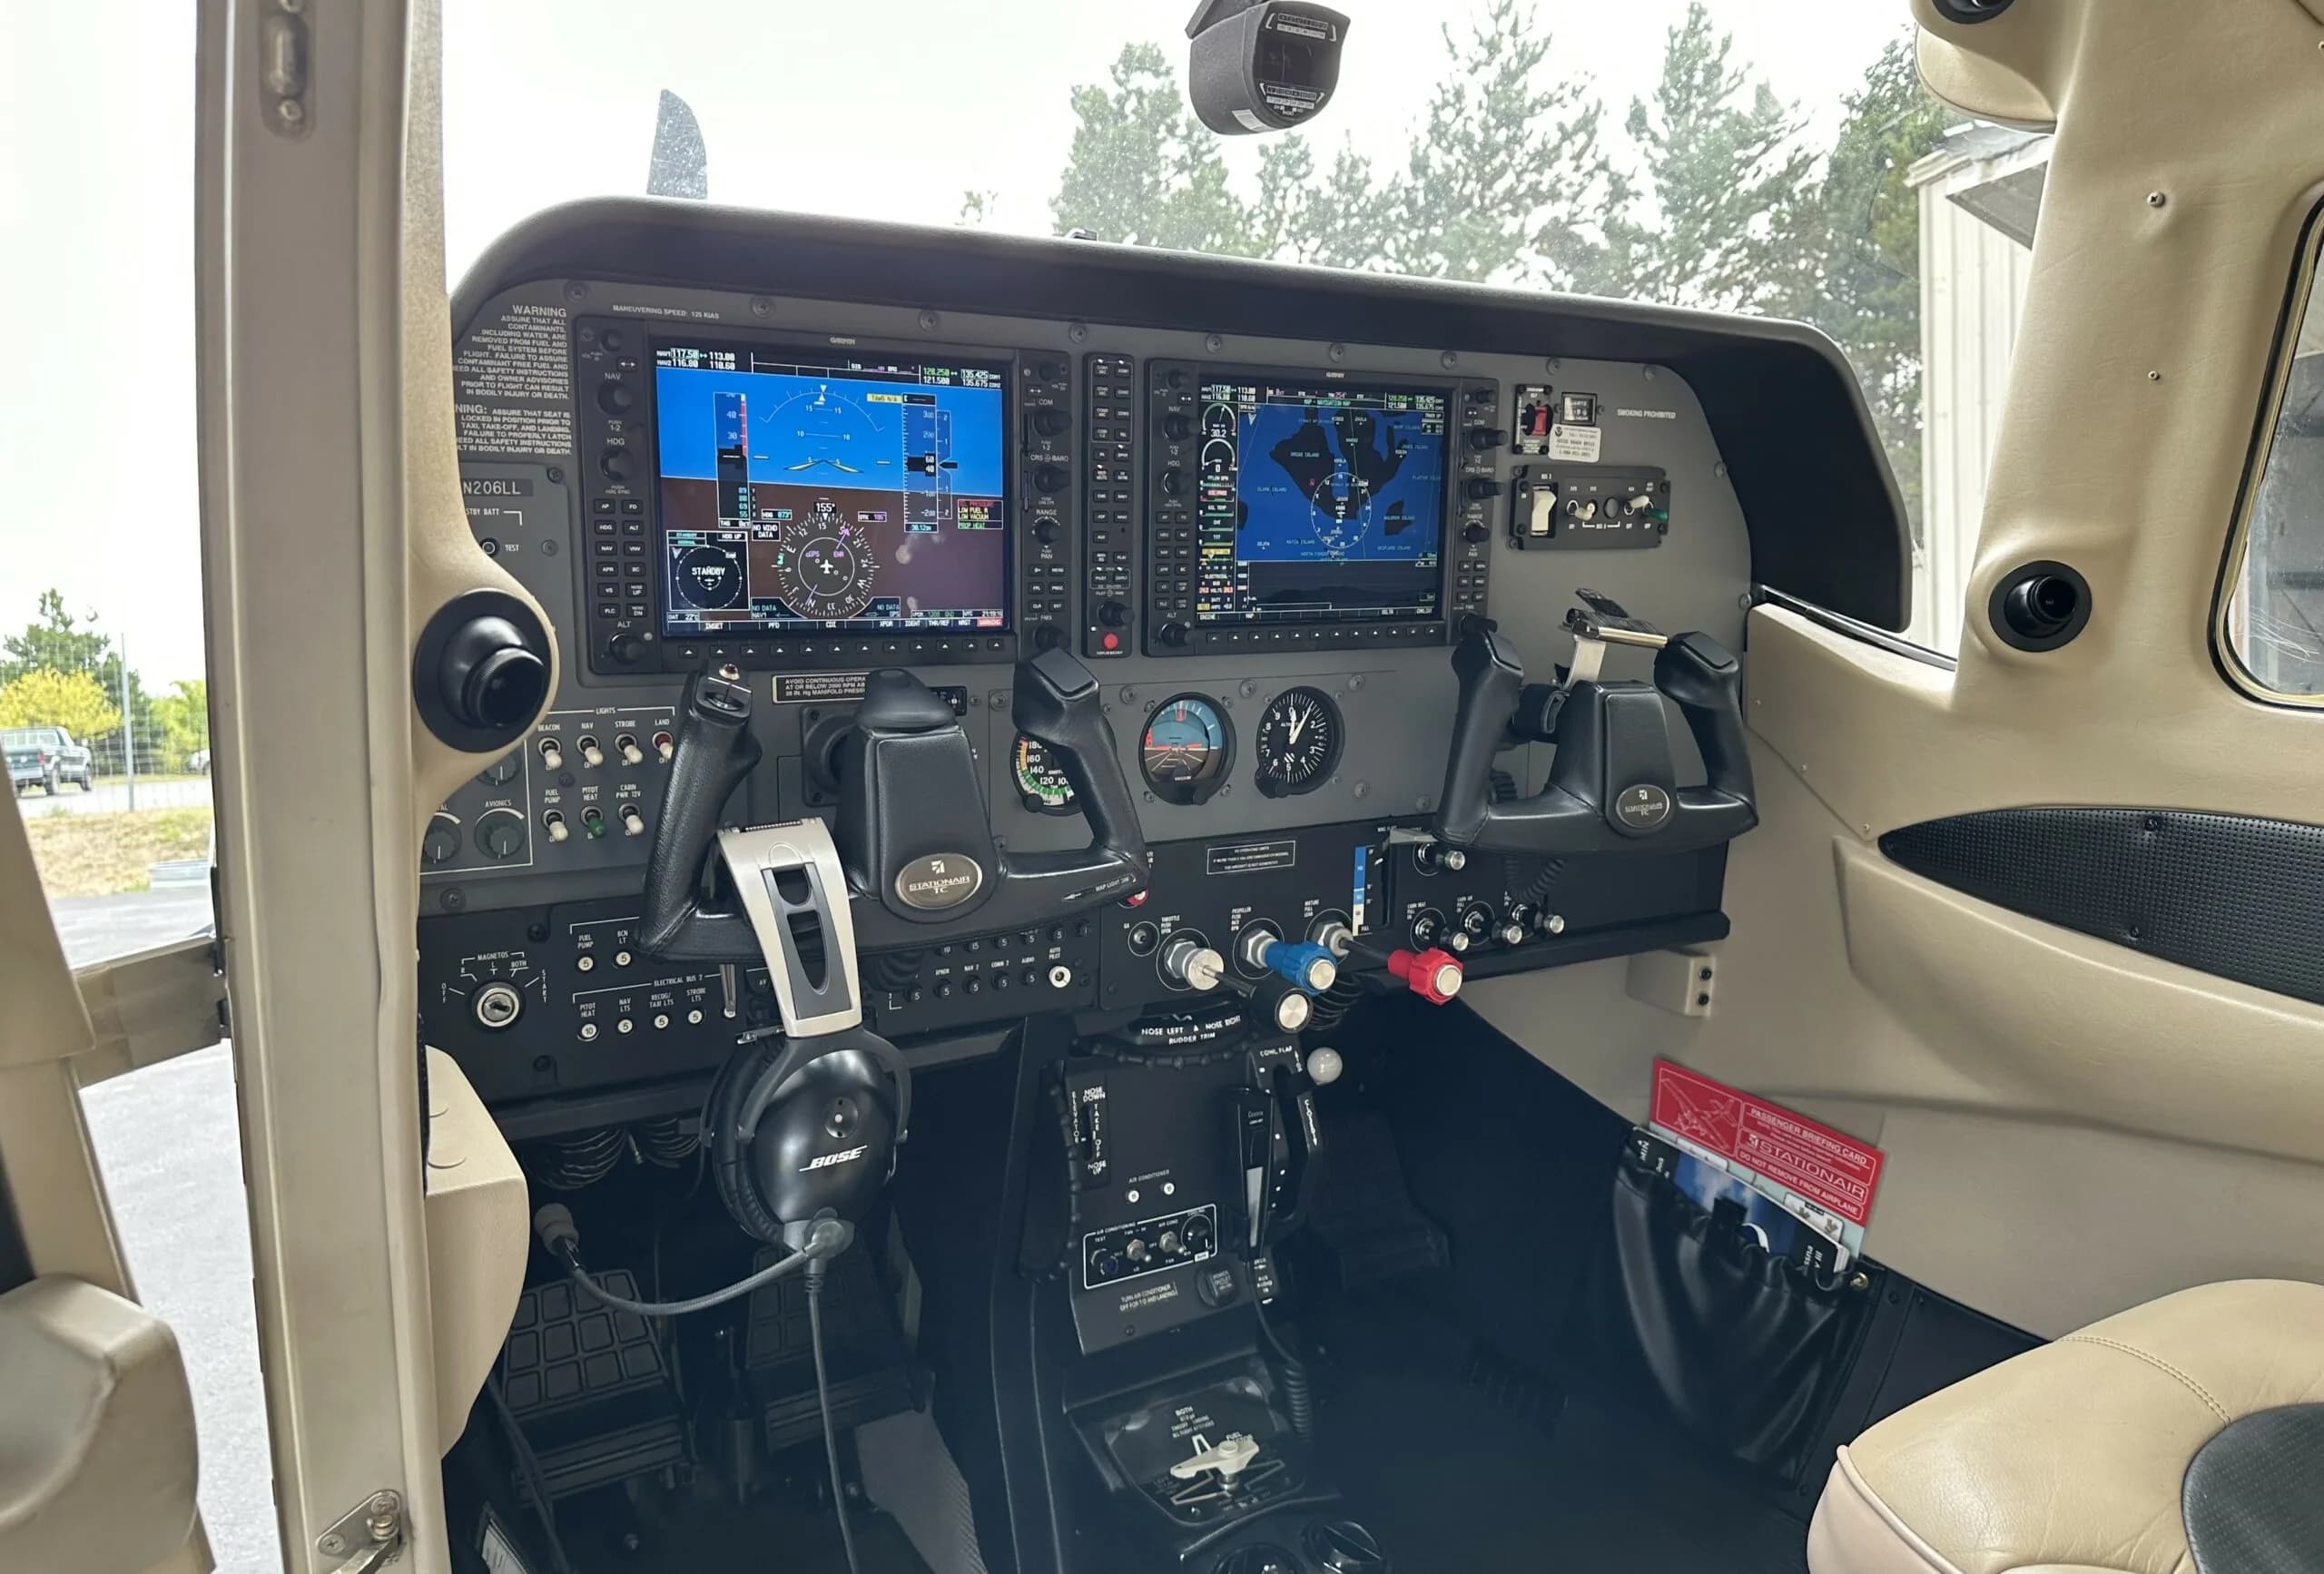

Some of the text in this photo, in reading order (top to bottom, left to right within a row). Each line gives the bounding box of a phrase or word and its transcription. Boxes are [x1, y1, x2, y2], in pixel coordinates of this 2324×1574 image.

[512, 305, 566, 318] WARNING
[613, 304, 663, 315] MANEUVERING
[501, 315, 530, 323] ASSURE
[482, 329, 520, 338] INCLUDING
[523, 331, 550, 340] WATER,
[472, 336, 508, 344] REMOVED
[509, 338, 530, 346] FROM
[508, 346, 537, 354] SYSTEM
[496, 352, 526, 360] FAILURE
[539, 355, 567, 363] ASSURE
[458, 358, 510, 367] CONTAMINANT
[533, 361, 552, 369] FUEL
[605, 372, 621, 380] NAV
[1617, 408, 1677, 419] SMOKING PROHIBITED
[1211, 429, 1226, 438] 30.2
[463, 480, 521, 495] N206LL
[465, 507, 500, 516] STBY BATT
[816, 503, 836, 512] 155°
[818, 522, 827, 530] 15
[787, 546, 795, 554] E
[692, 567, 725, 575] STANDBY
[805, 676, 844, 684] CONTINUOUS
[596, 707, 616, 715] LIGHTS
[1275, 712, 1281, 720] 9
[581, 722, 594, 730] NAV
[615, 720, 635, 728] STROBE
[655, 718, 670, 726] LAND
[1310, 721, 1315, 729] 2
[537, 723, 560, 732] BEACON
[1265, 749, 1270, 757] 7
[1309, 745, 1315, 754] 3
[1026, 754, 1041, 762] 160
[1273, 758, 1278, 766] 6
[1029, 765, 1045, 774] 140
[1286, 763, 1291, 772] 5
[1039, 776, 1054, 784] 120
[485, 799, 512, 808] AVIONICS
[909, 875, 970, 892] STATIONAIR
[934, 886, 949, 894] TC
[577, 941, 594, 949] PUMP
[478, 951, 508, 960] MAGNETOS
[511, 960, 527, 969] BOTH
[583, 959, 588, 968] 5
[686, 987, 706, 996] STROBE
[652, 992, 672, 1001] RECOG/
[580, 1003, 596, 1011] PITOT
[693, 1013, 699, 1021] 5
[658, 1018, 665, 1026] 5
[1141, 1015, 1241, 1036] NOSE LEFT NOSE RIGHT
[585, 1027, 594, 1035] 10
[1169, 1035, 1196, 1045] RUDDER
[1084, 1086, 1103, 1096] NOSE
[1082, 1091, 1106, 1103] DOWN
[1750, 1107, 1801, 1133] PASSENGER
[1802, 1128, 1841, 1155] BRIEFING
[1842, 1148, 1867, 1166] CARD
[809, 1147, 863, 1170] BOSE
[1088, 1160, 1107, 1169] NOSE
[1759, 1140, 1865, 1198] STATIONAIR
[1092, 1167, 1101, 1176] UP
[1128, 1168, 1170, 1184] AIR CONDITIONER
[1739, 1150, 1859, 1215] DO NOT REMOVE FROM AIRPLANE
[1175, 1405, 1194, 1416] BOTH
